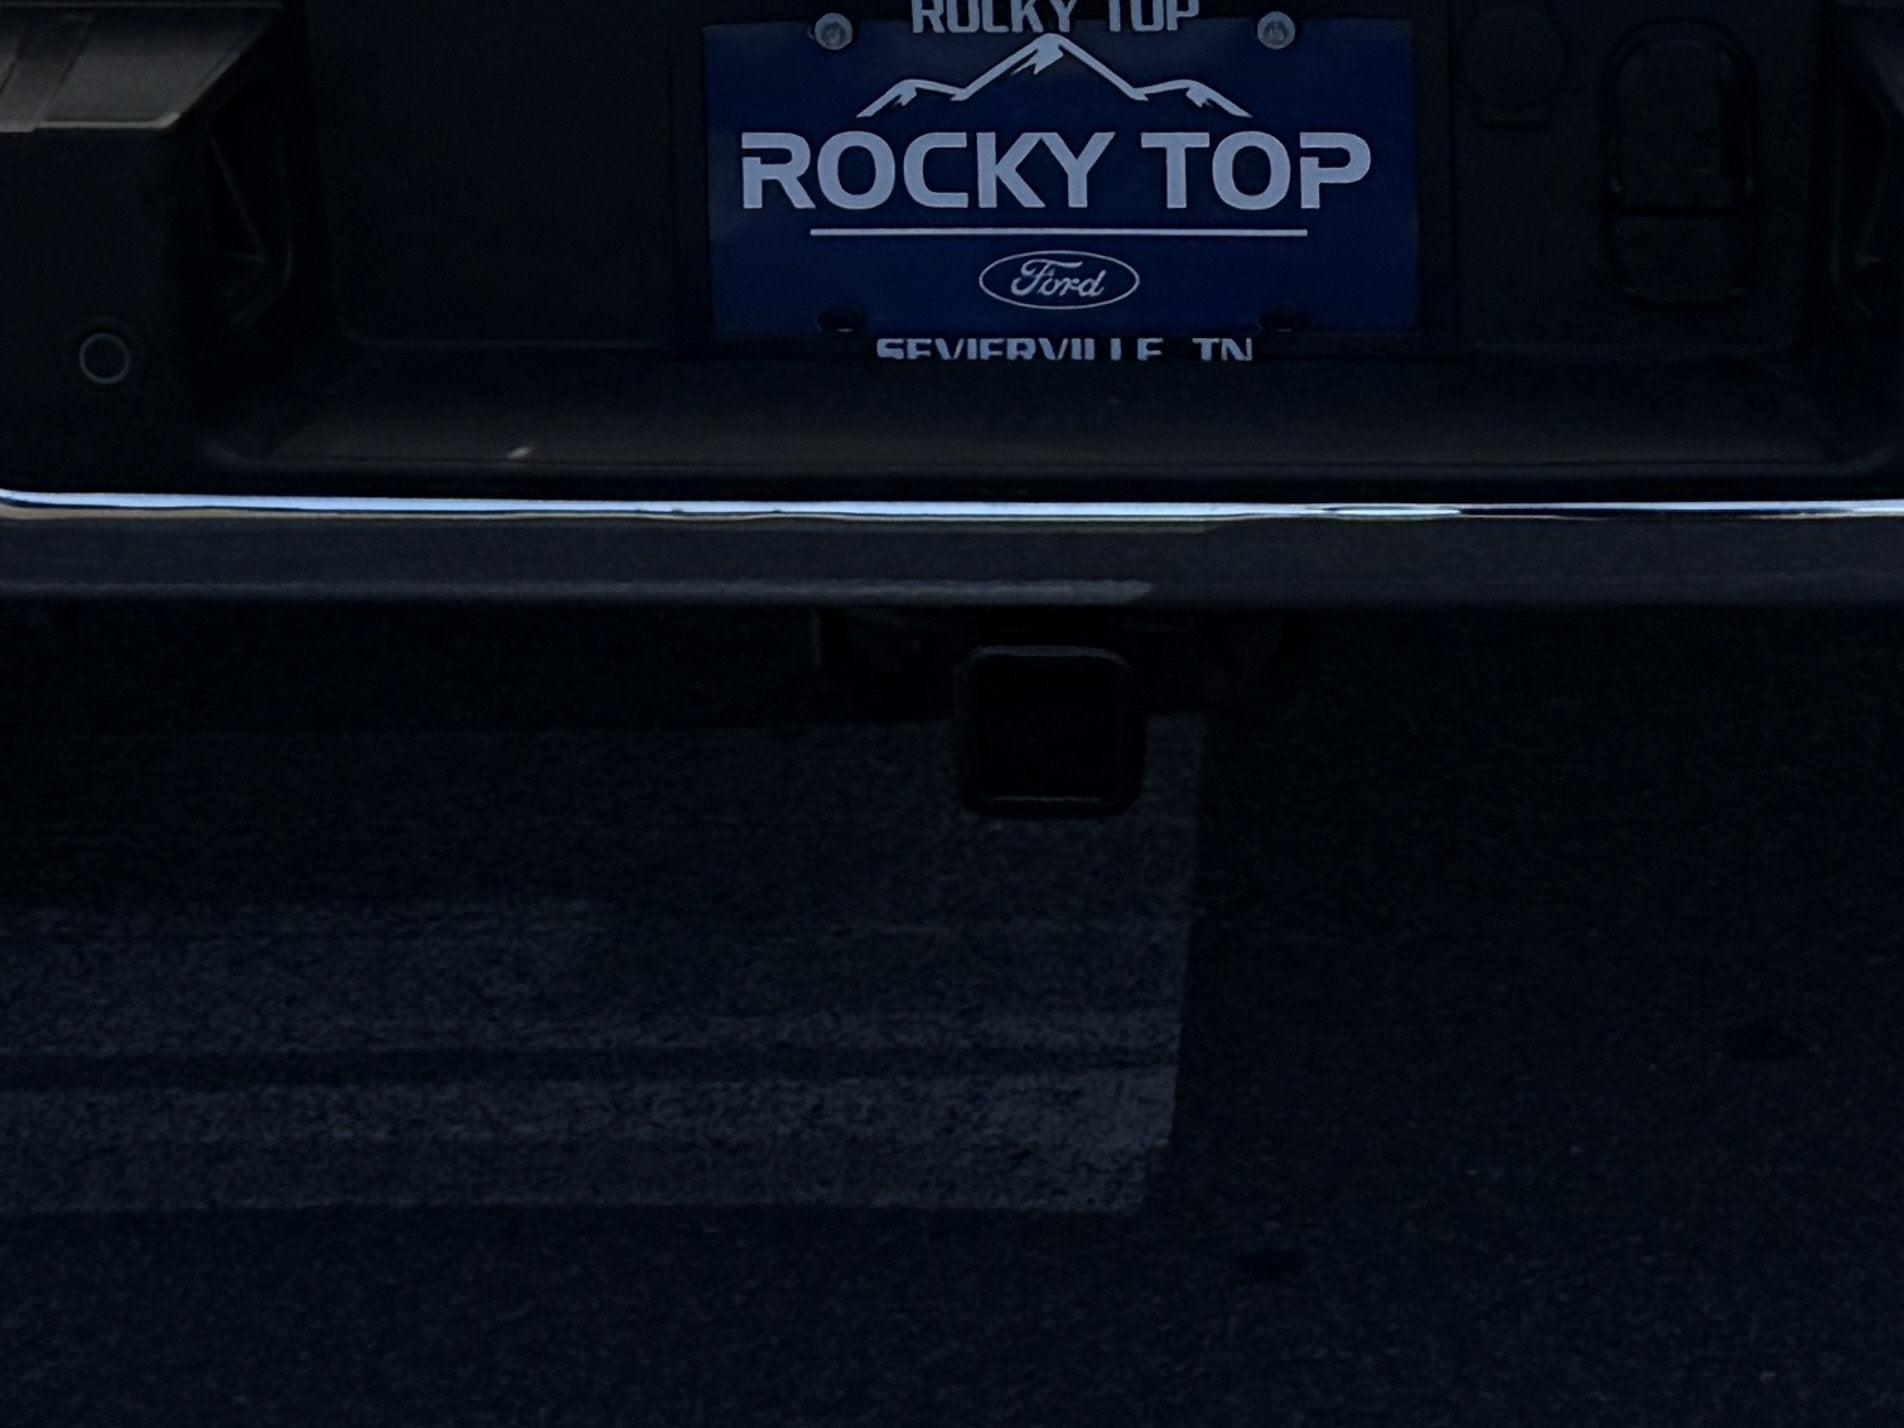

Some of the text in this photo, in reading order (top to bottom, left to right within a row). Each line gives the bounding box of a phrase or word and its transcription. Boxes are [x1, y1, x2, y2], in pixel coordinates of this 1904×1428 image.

[740, 129, 1372, 211] ROCKY TOP
[1009, 258, 1105, 299] Ford
[1191, 336, 1254, 362] TN
